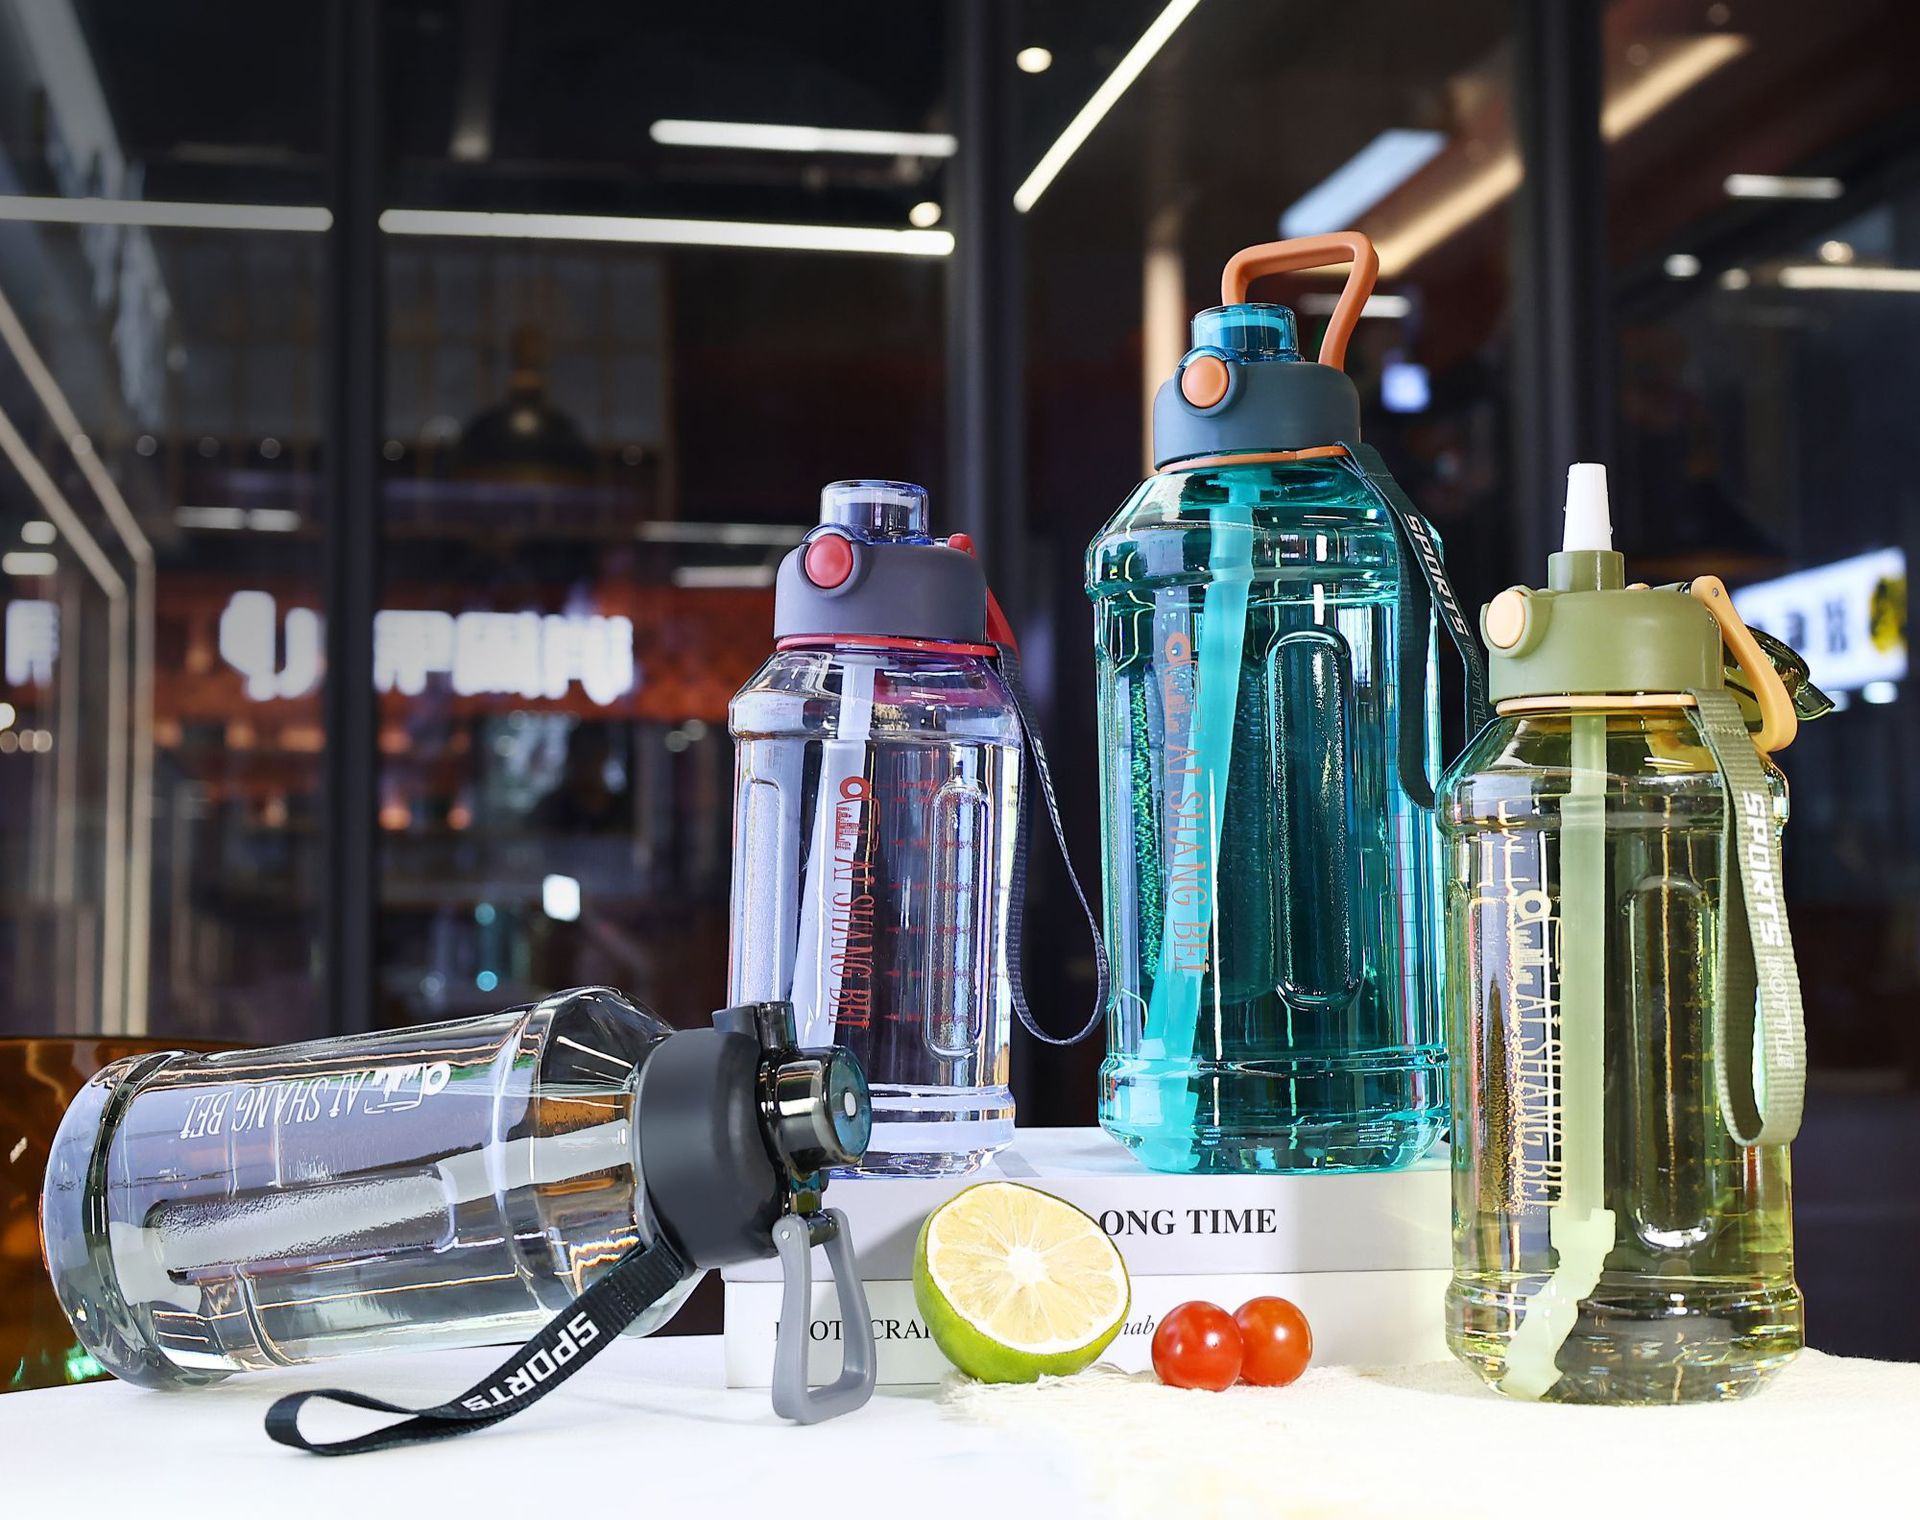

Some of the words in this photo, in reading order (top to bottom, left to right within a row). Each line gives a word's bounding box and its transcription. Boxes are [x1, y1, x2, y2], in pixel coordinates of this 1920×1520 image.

[1404, 512, 1470, 637] SPORTS
[1167, 744, 1203, 775] AI
[833, 856, 876, 883] AI
[1168, 791, 1207, 906] SHANG
[1743, 790, 1784, 948] SPORTS
[830, 893, 875, 979] SHANG
[1172, 920, 1210, 974] BEI
[828, 987, 872, 1030] BEI
[180, 1089, 234, 1139] BEI
[231, 1077, 329, 1133] SHANG
[329, 1072, 370, 1117] AI
[1099, 1208, 1176, 1236] ONG
[1186, 1208, 1278, 1235] TIME
[461, 1311, 600, 1412] SPORTS
